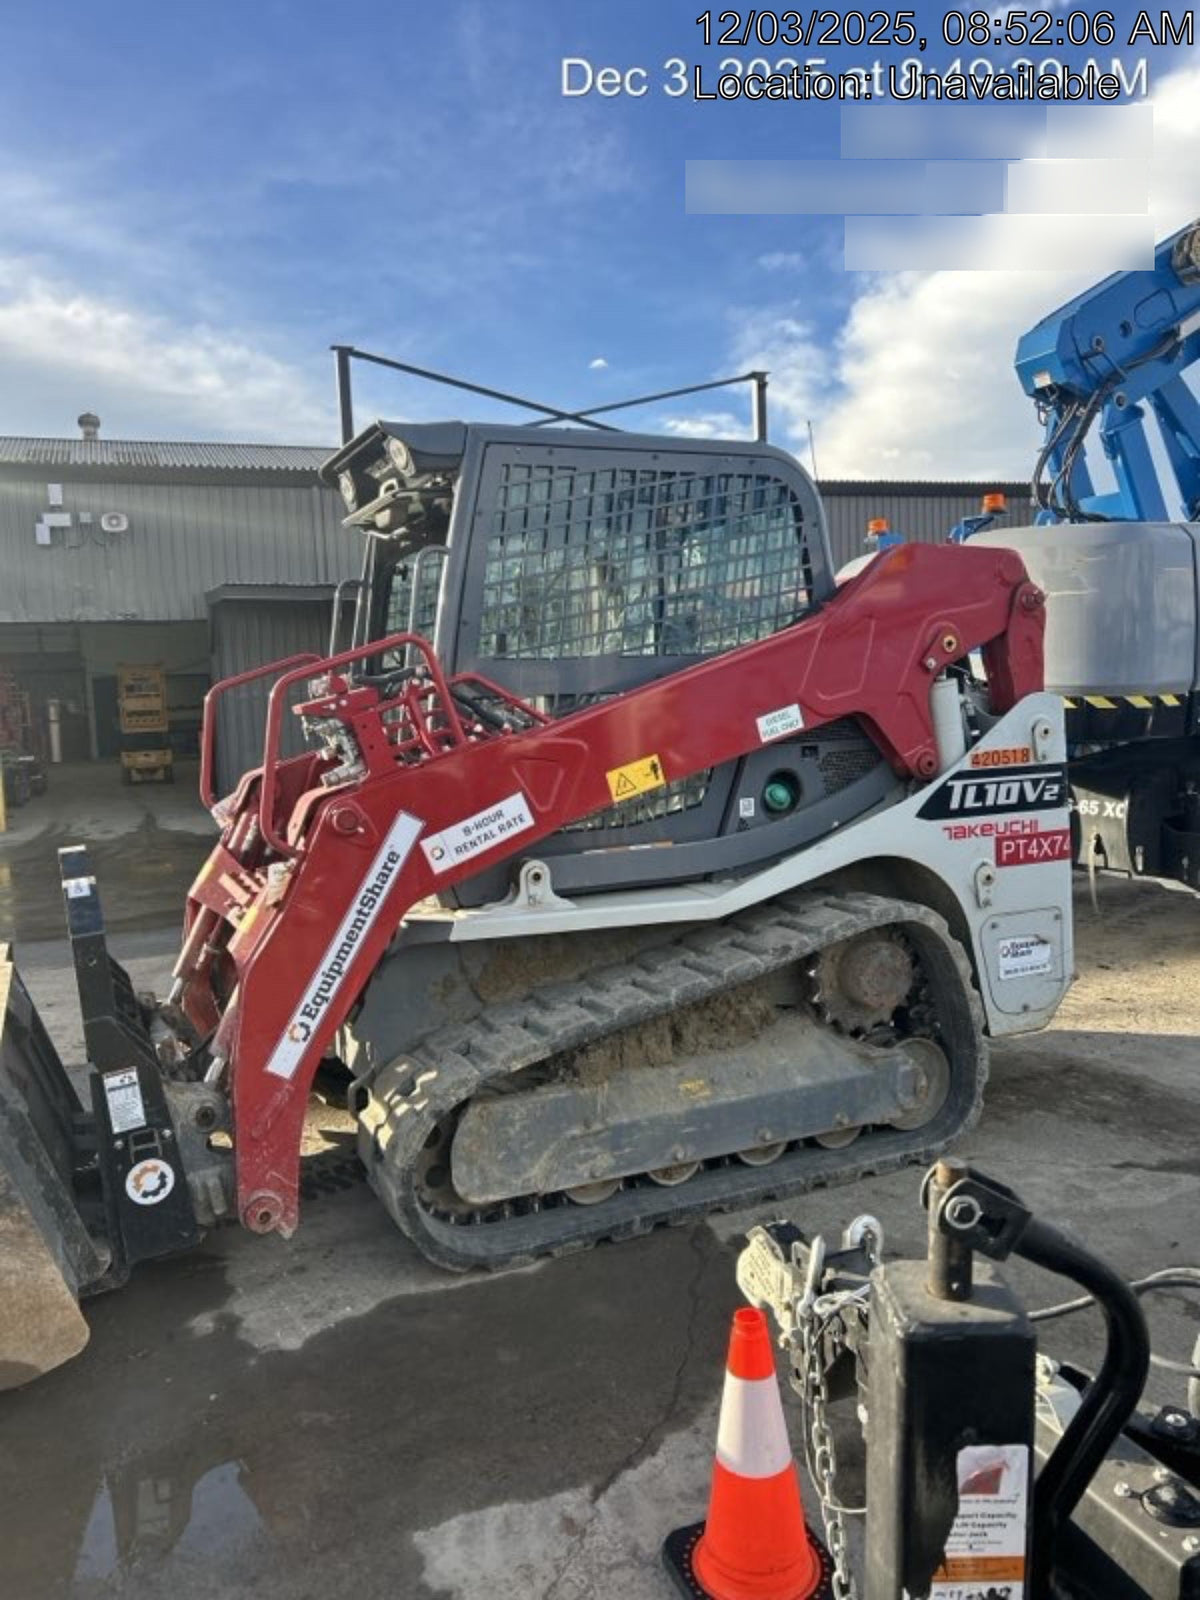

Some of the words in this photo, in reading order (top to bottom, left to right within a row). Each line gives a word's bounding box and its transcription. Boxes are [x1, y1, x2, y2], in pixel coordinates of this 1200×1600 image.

[971, 747, 1031, 767] 420518
[946, 778, 1061, 811] TL10V2
[454, 830, 497, 856] RENTAL
[498, 813, 526, 834] RATE
[462, 809, 505, 836] 8-HOUR
[300, 849, 401, 1021] EquipmentShare
